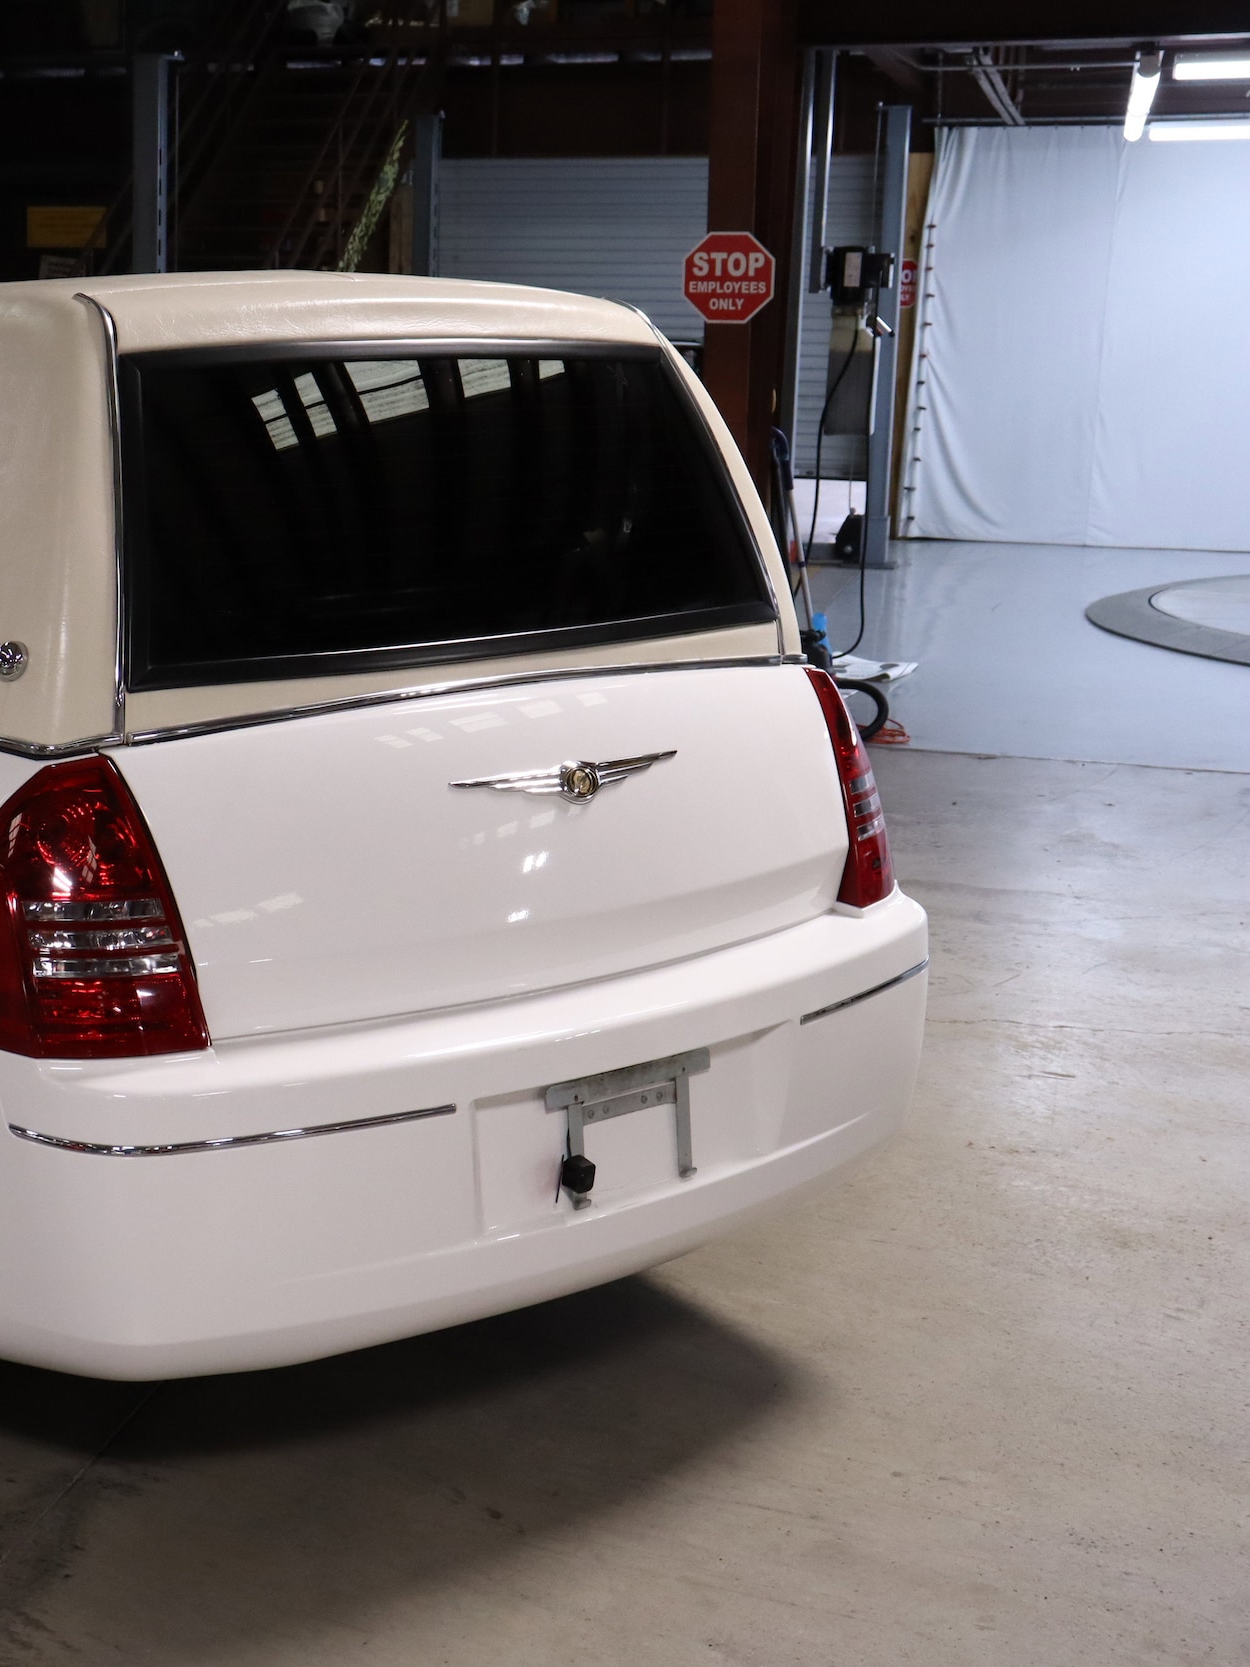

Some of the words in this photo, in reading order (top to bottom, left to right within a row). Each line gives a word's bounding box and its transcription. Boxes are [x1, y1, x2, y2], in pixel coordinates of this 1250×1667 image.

[692, 251, 766, 277] STOP
[688, 281, 767, 294] EMPLOYEES
[709, 298, 745, 311] ONLY
